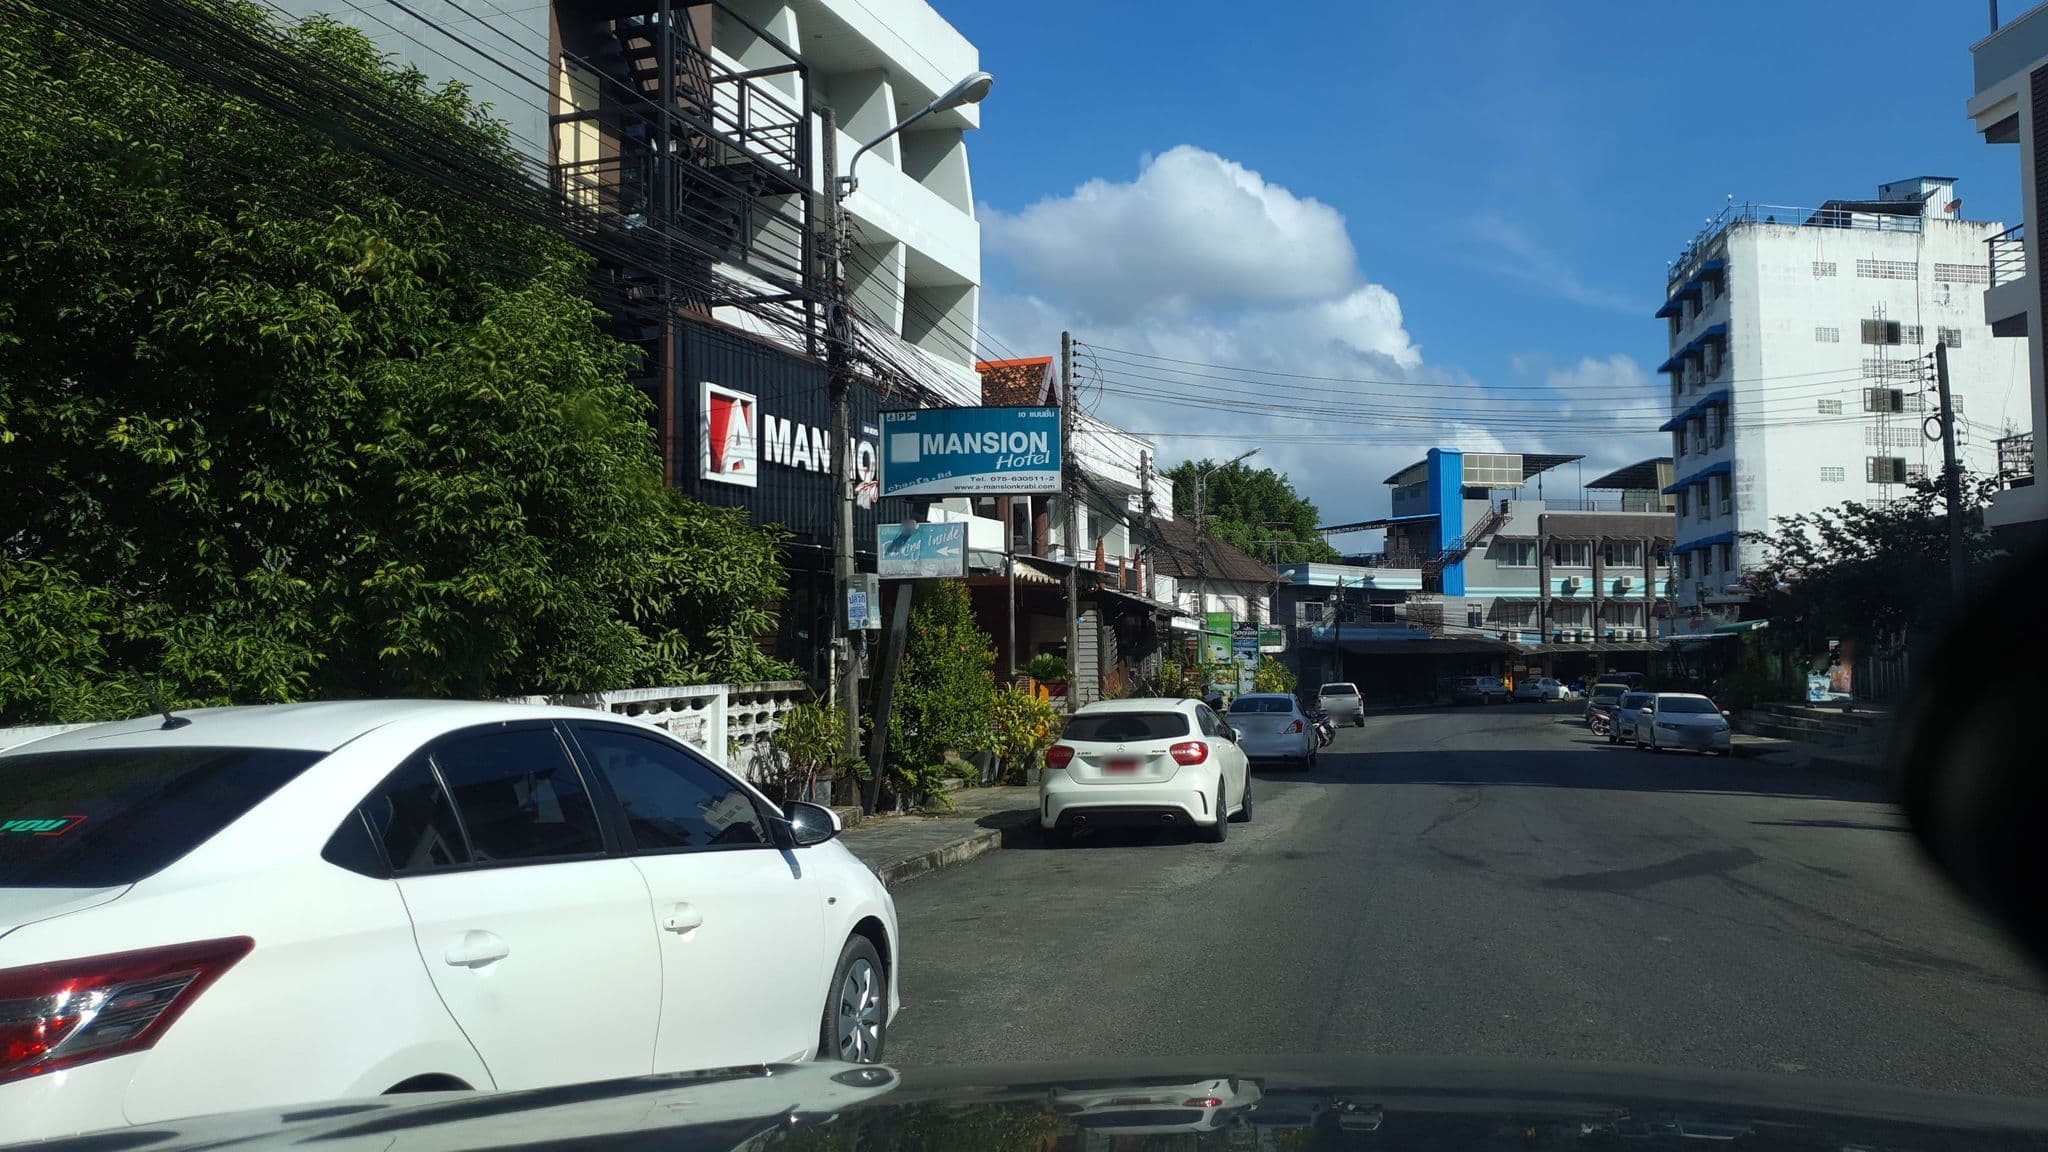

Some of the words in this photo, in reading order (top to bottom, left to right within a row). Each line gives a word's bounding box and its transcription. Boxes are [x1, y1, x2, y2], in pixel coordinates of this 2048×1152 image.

[764, 413, 879, 482] MANIO
[923, 431, 1048, 455] MANSION
[995, 450, 1050, 470] Hotel
